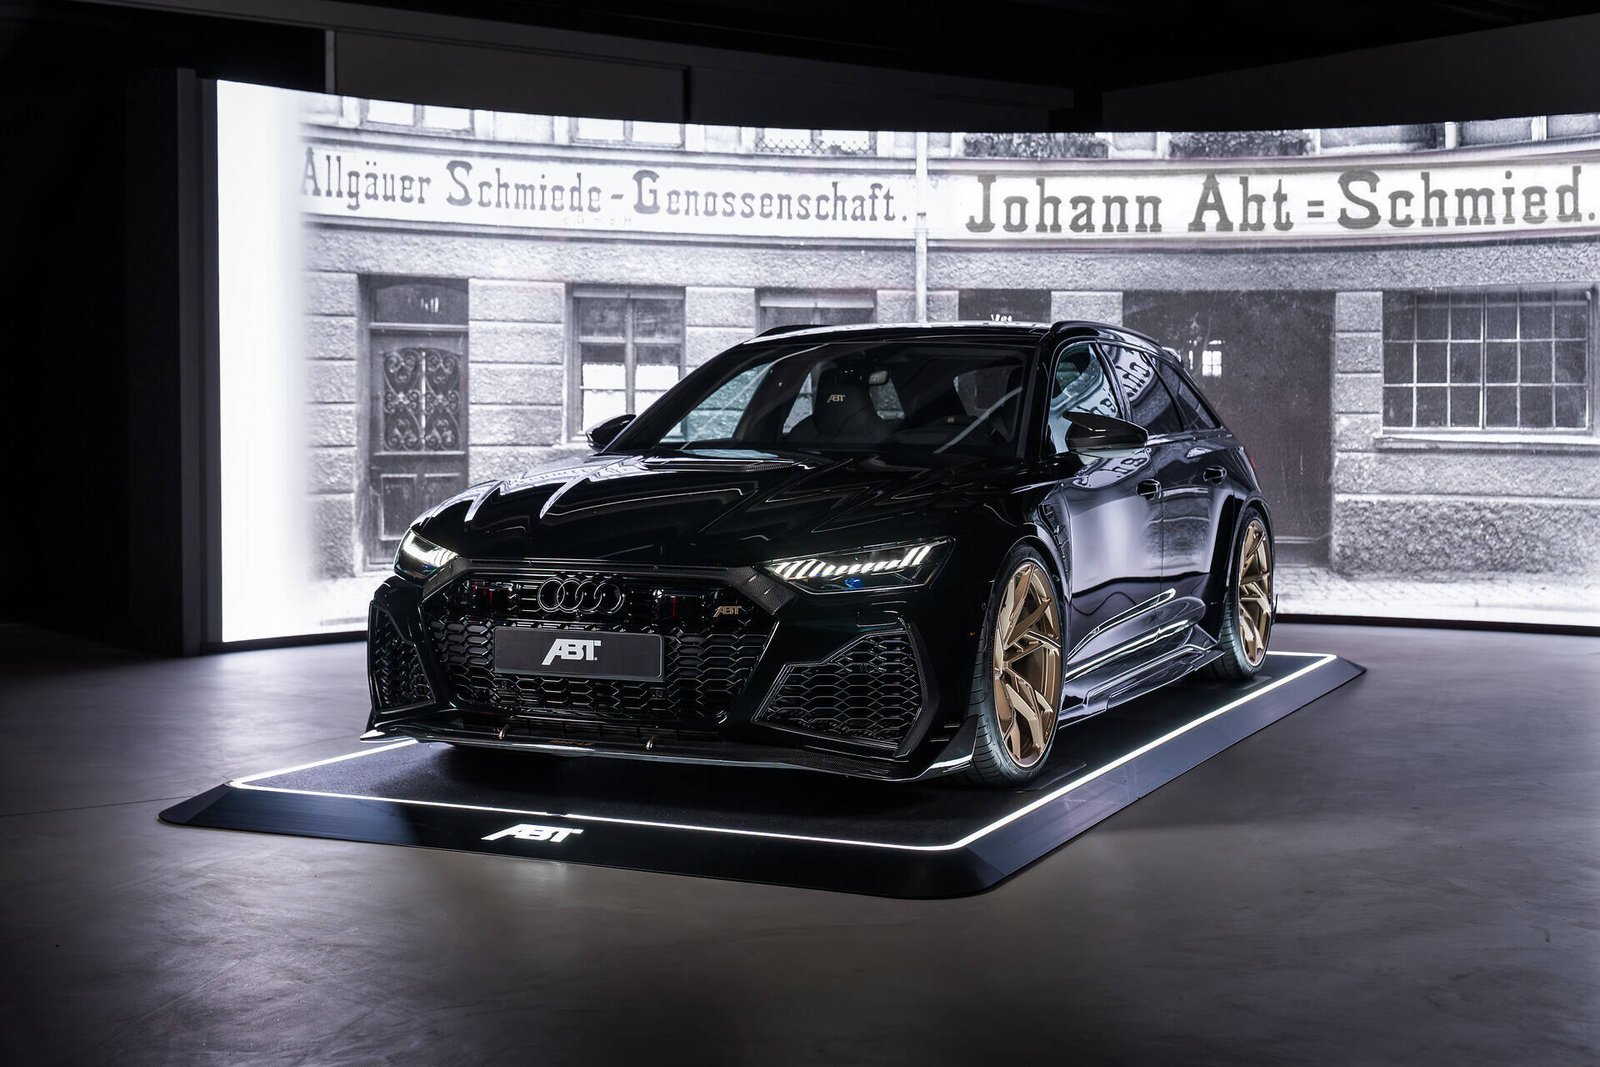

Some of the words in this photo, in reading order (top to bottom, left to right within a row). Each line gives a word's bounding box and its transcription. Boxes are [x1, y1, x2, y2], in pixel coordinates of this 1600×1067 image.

[301, 147, 432, 211] Allgäuer
[965, 174, 1162, 233] Johann
[827, 394, 846, 403] ABT
[713, 605, 742, 618] ABT
[481, 823, 584, 843] ABT
